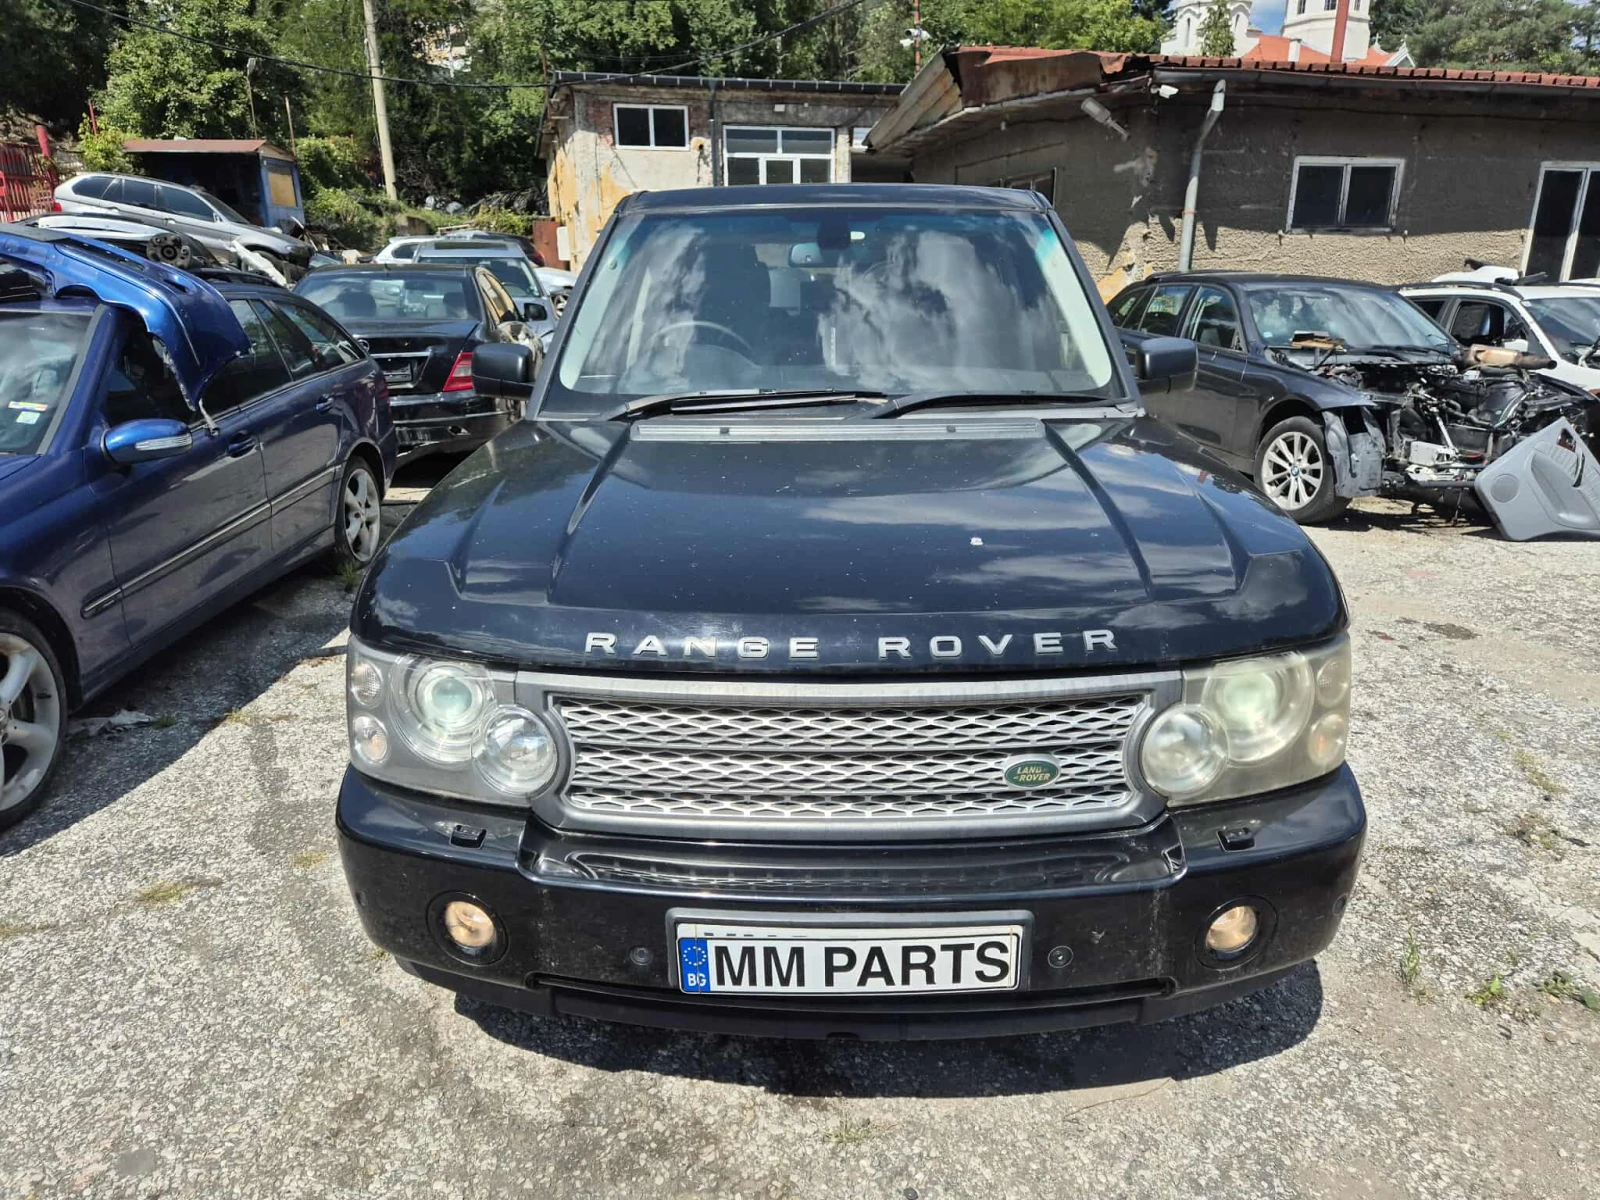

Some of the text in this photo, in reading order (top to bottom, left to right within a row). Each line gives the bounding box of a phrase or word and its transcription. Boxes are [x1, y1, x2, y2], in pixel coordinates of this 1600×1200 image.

[584, 628, 1118, 660] RANGE ROVER
[1017, 766, 1041, 774] LAND
[1019, 773, 1051, 782] ROVER
[714, 941, 1010, 987] MM PARTS
[687, 972, 707, 987] BG
